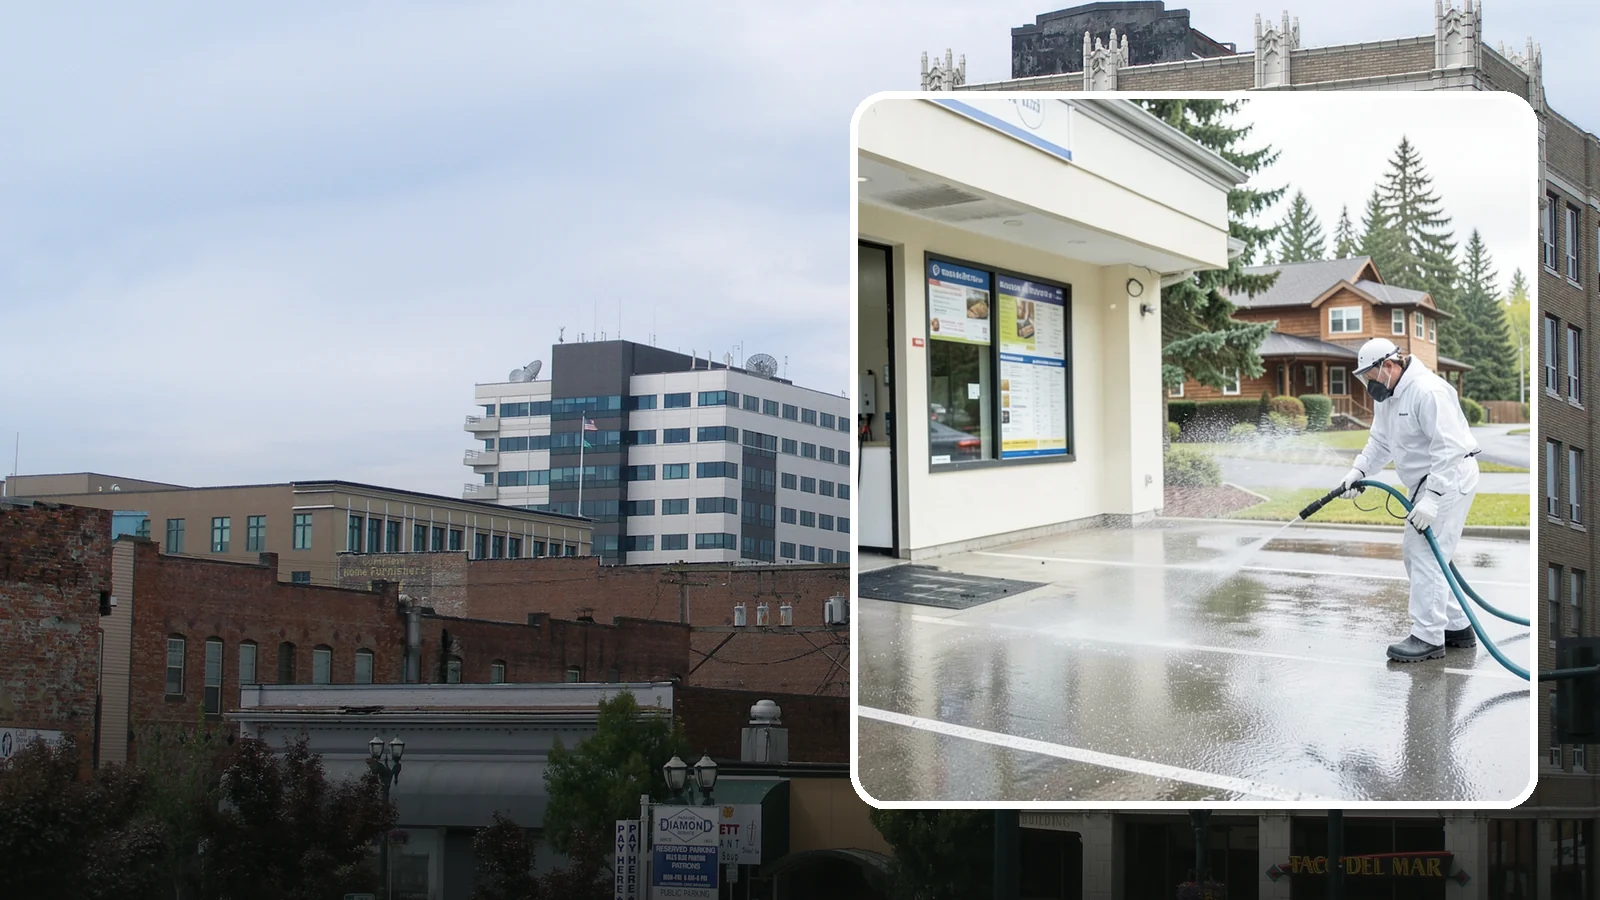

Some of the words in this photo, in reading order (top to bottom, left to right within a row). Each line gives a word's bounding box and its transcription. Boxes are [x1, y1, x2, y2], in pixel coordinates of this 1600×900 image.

[370, 566, 427, 576] Furnishers
[660, 818, 713, 833] DIAMOND
[1022, 815, 1070, 828] BUILDING
[617, 824, 625, 852] PAY
[628, 824, 636, 852] PAY
[656, 845, 688, 853] RESERVED
[689, 846, 716, 854] PARKING
[671, 861, 701, 870] PATRONS
[1345, 856, 1384, 876] DEL
[1392, 857, 1442, 877] MAR
[616, 855, 625, 894] HERE
[627, 855, 636, 893] HERE
[660, 888, 681, 897] PUBLIC
[683, 889, 710, 899] PARKING
